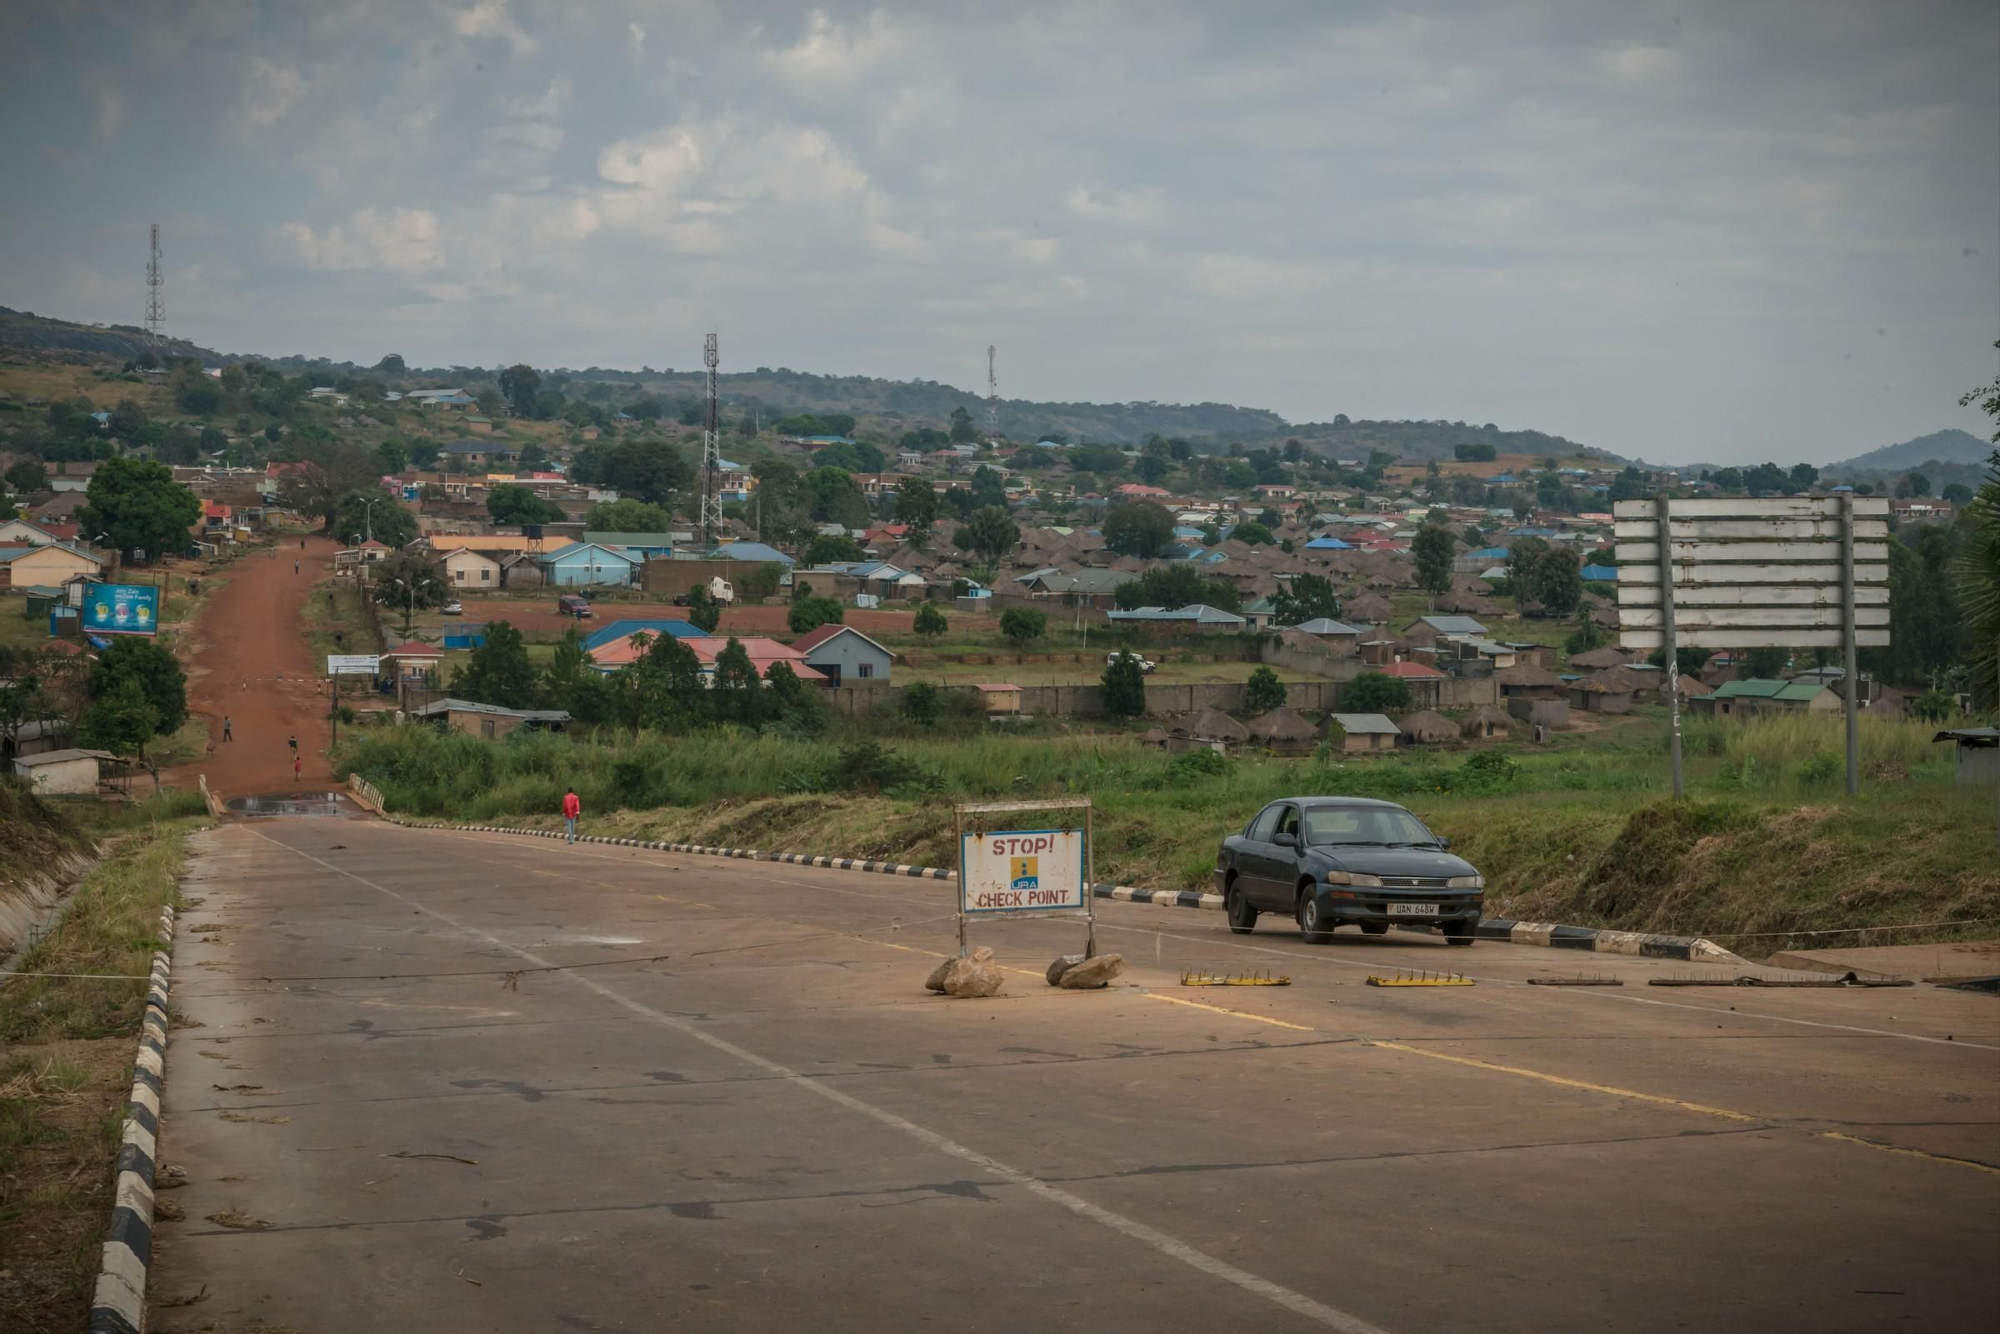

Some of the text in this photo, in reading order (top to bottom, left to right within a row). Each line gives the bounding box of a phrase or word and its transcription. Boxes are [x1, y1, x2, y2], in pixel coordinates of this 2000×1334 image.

[992, 834, 1055, 856] STOP!
[1012, 880, 1037, 889] URA
[978, 889, 1068, 908] CHECK POINT
[1396, 904, 1412, 914] UAN
